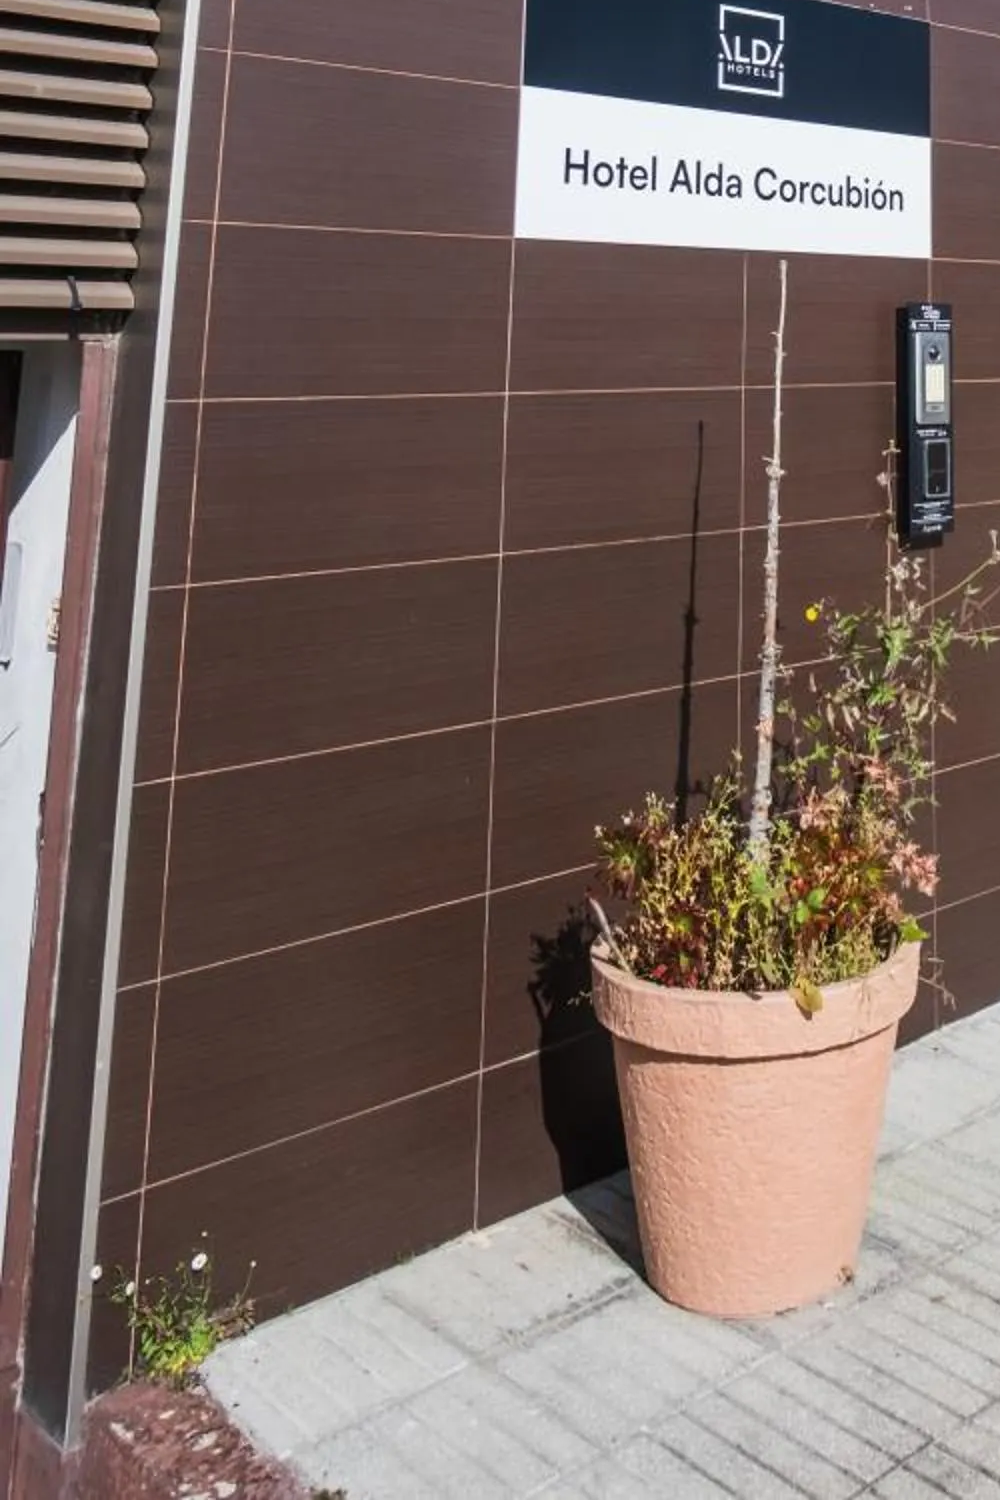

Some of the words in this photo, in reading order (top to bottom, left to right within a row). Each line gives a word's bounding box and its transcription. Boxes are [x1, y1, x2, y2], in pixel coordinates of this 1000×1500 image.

[718, 33, 785, 70] ALDA
[727, 62, 776, 80] HOTELS
[563, 147, 658, 193] Hotel
[669, 160, 742, 199] Alda
[753, 167, 904, 212] Corcubión
